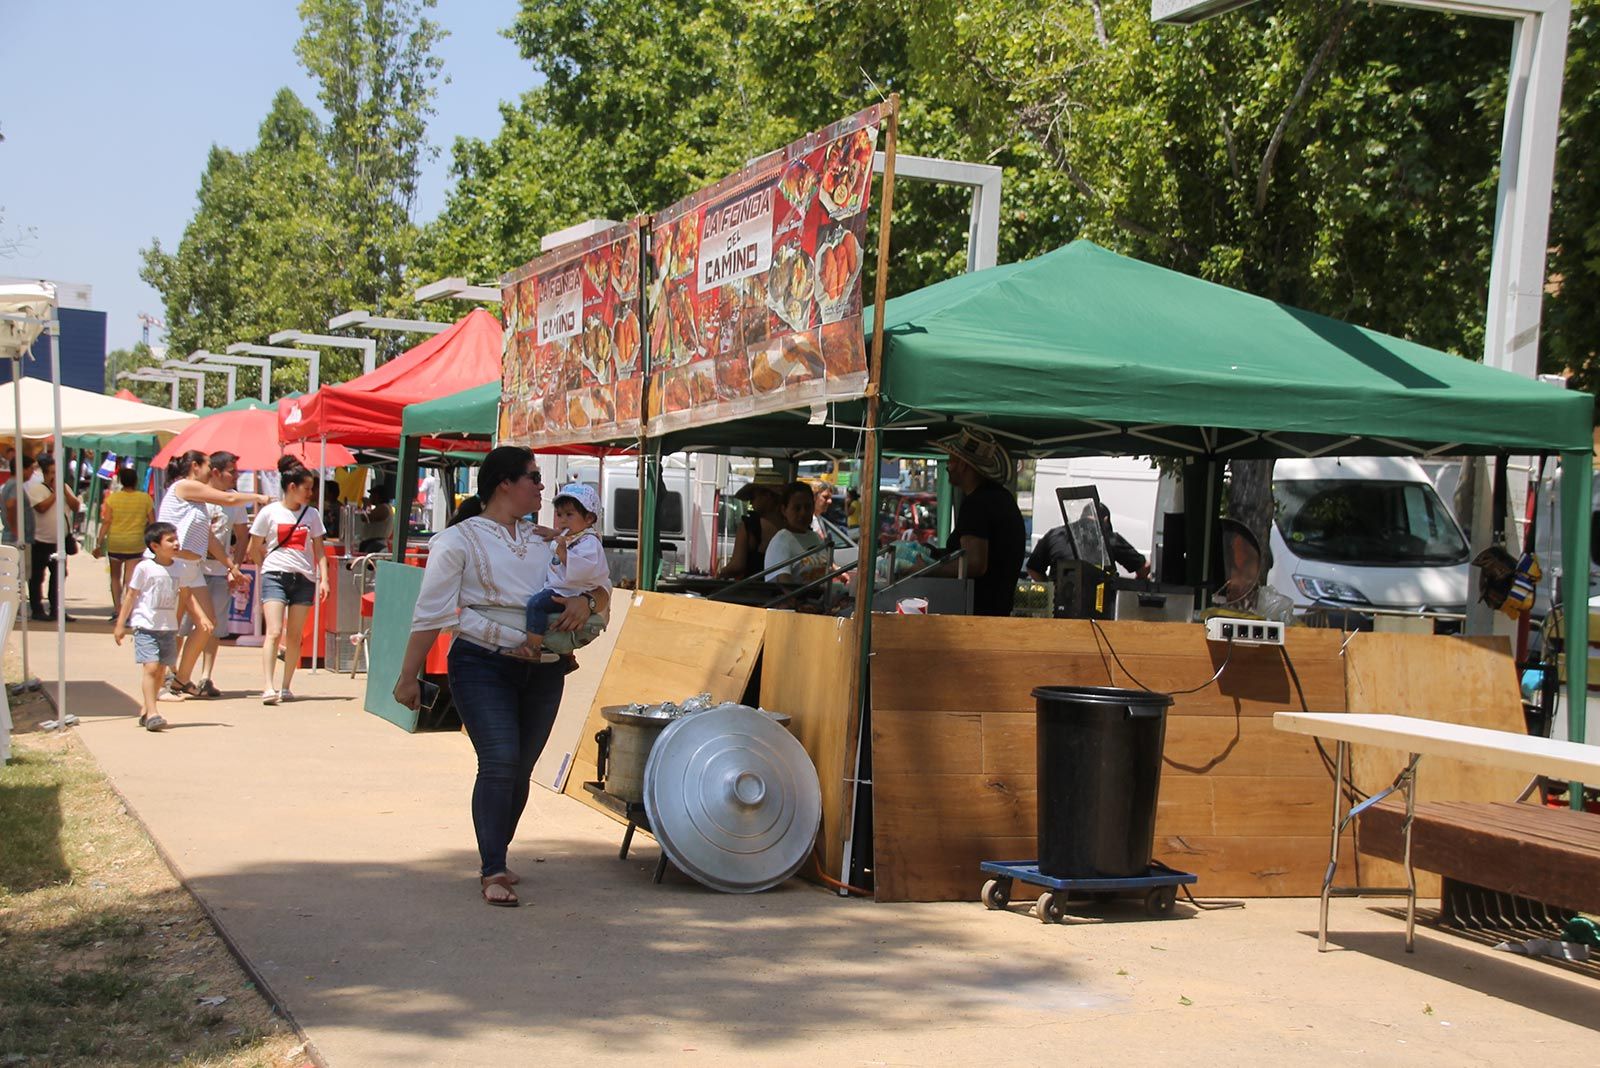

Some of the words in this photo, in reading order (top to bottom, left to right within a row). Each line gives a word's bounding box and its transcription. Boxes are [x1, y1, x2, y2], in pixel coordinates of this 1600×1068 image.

[703, 211, 718, 239] LA
[721, 191, 770, 232] FONDA
[705, 243, 758, 284] CAMINO
